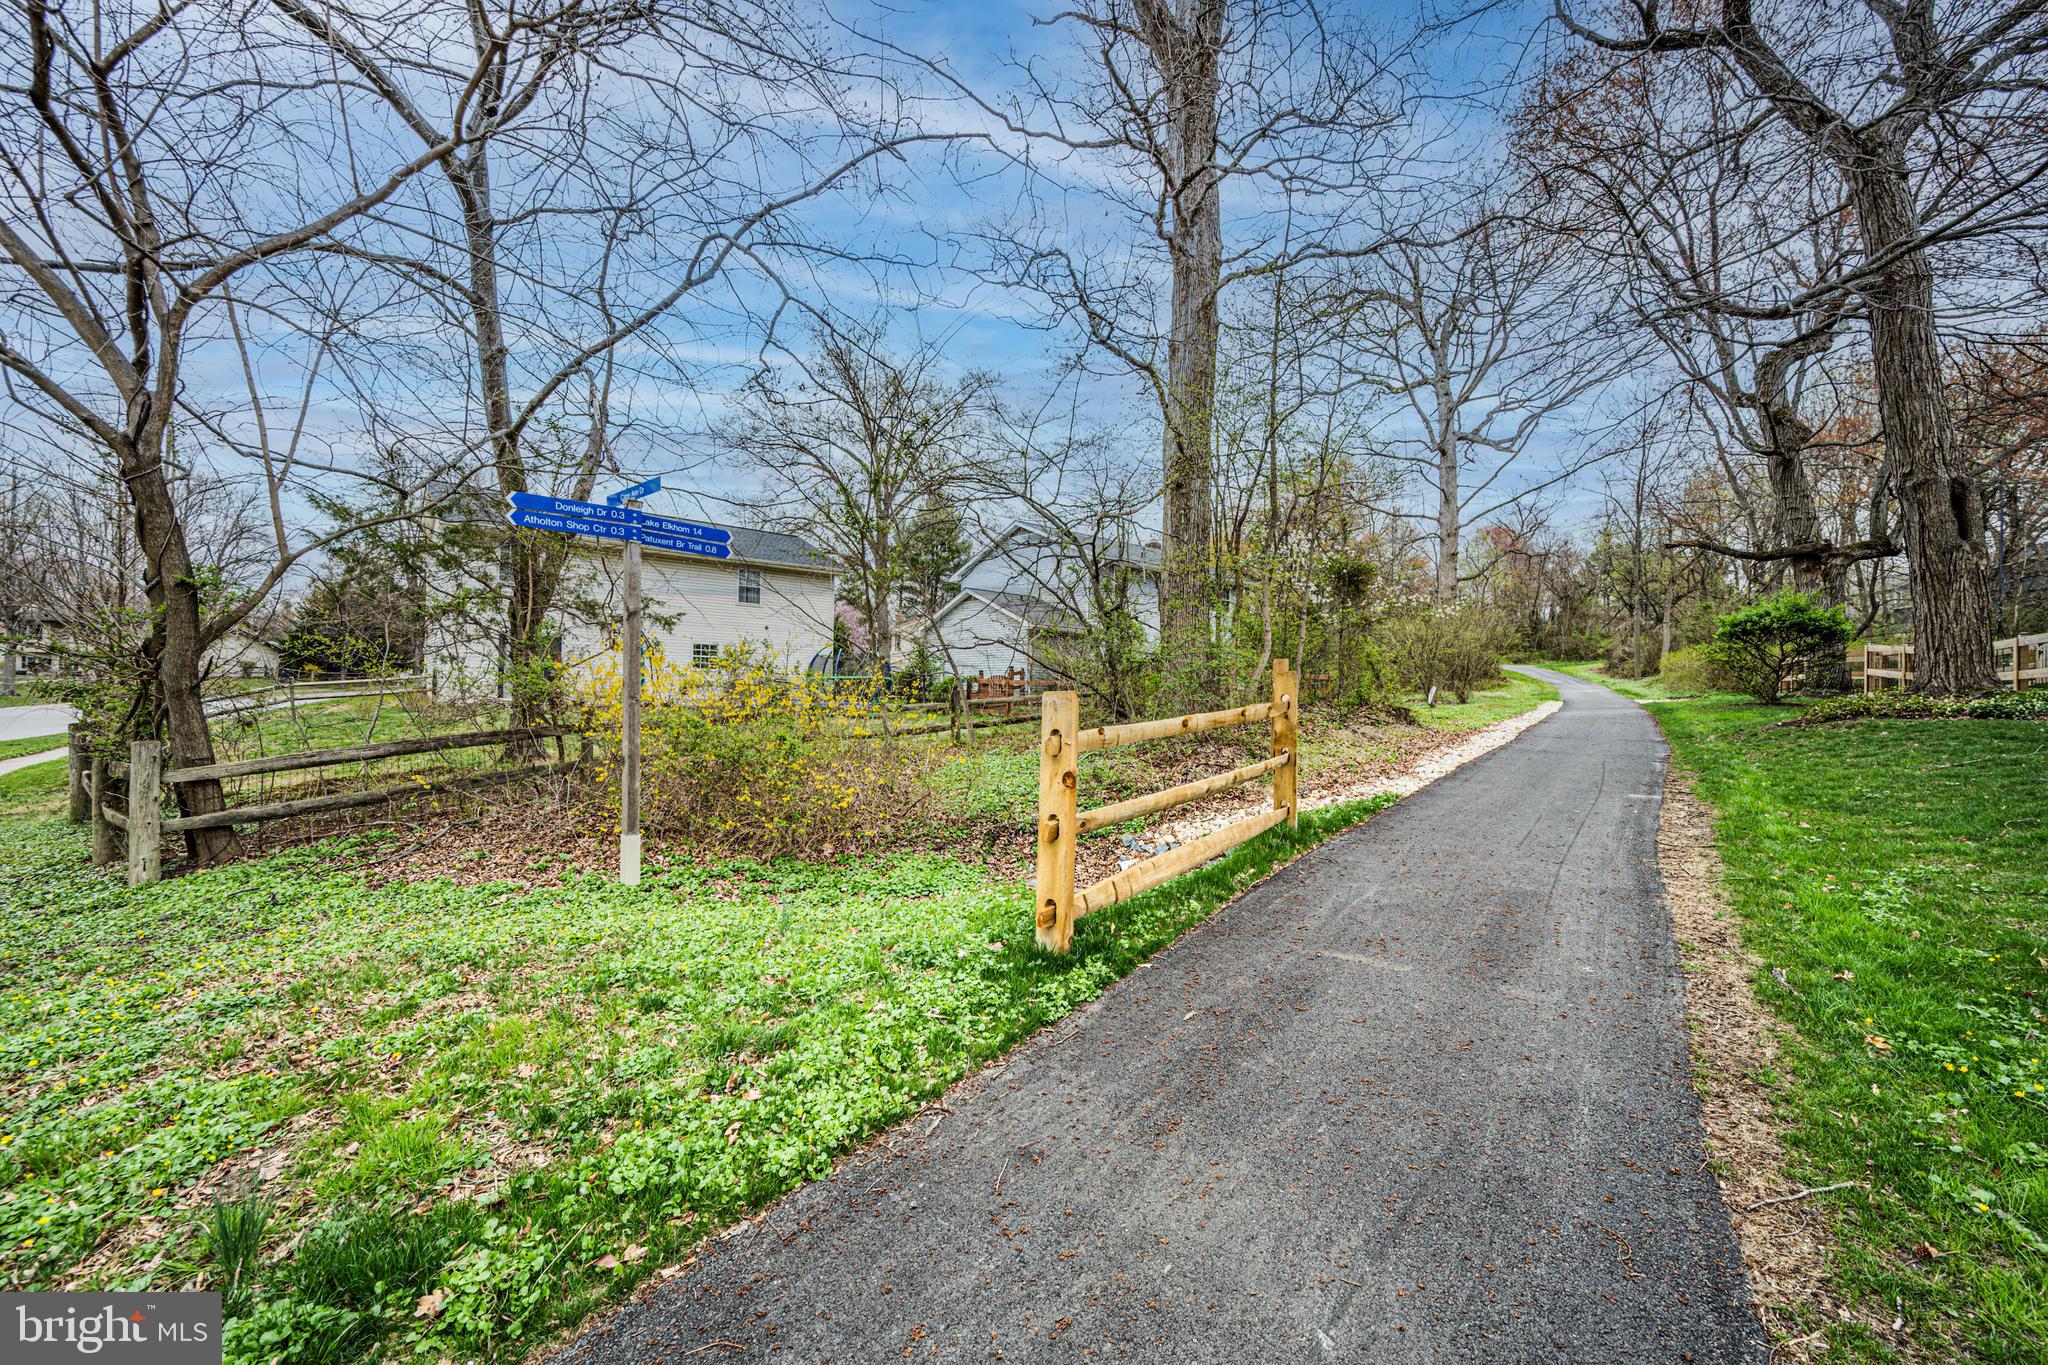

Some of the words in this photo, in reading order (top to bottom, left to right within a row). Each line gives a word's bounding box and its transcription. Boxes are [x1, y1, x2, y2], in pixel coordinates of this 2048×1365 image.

[555, 502, 594, 516] Donleigh
[596, 508, 607, 517] Dr
[610, 511, 625, 520] 0.3
[523, 514, 563, 528] Atholton
[566, 520, 590, 532] Shop
[592, 524, 607, 533] Ctr
[610, 526, 625, 536] 0.3
[662, 522, 690, 534] Elkhorn
[641, 533, 674, 547] Patuxent
[676, 539, 685, 549] Br
[687, 542, 702, 551] Trail
[704, 545, 717, 554] 0.8
